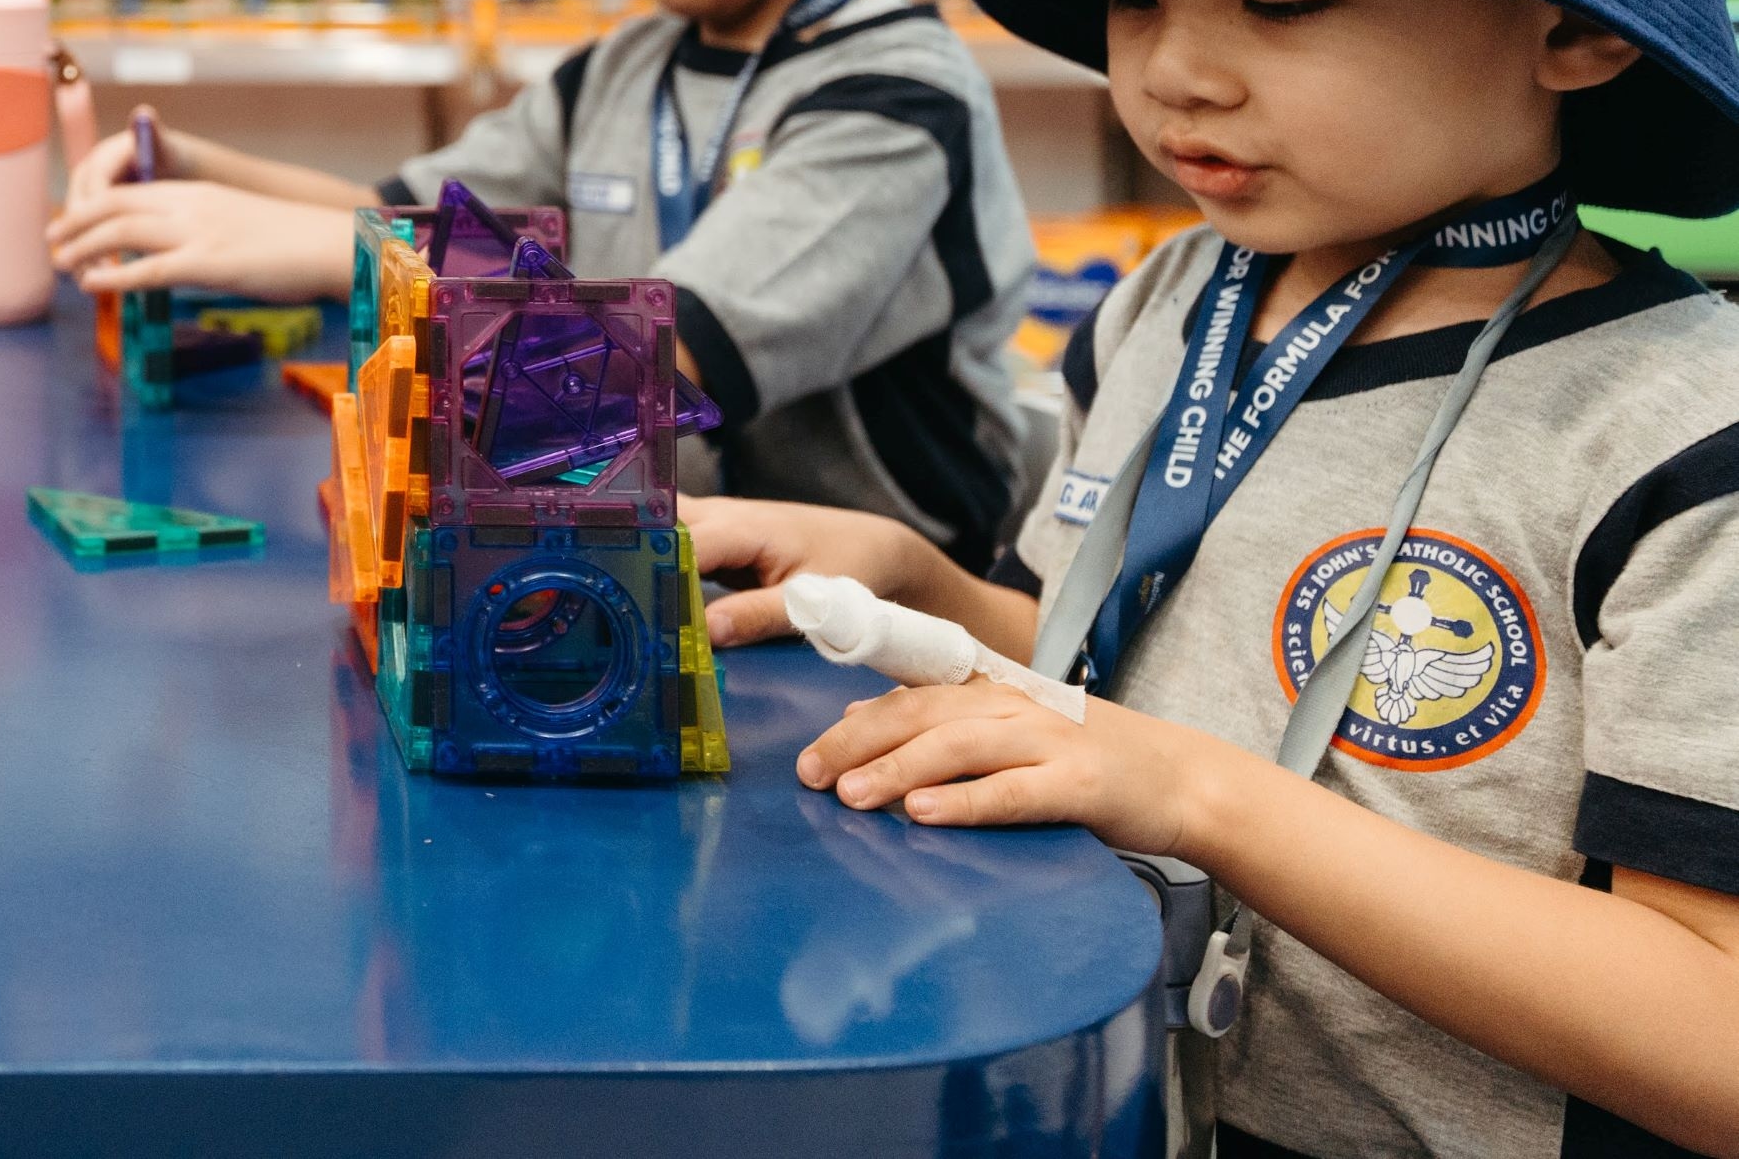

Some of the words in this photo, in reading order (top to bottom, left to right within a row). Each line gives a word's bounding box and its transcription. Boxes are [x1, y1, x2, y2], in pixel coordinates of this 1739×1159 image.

[1224, 244, 1255, 282] OR
[1435, 207, 1548, 249] INNING
[1189, 283, 1243, 401] WINNING
[1243, 303, 1351, 429] FORMULA
[1164, 406, 1207, 488] CHILD
[1310, 543, 1378, 589] JOHN'S
[1399, 542, 1489, 587] ATHOLIC
[1486, 584, 1528, 667] SCHOOL
[1349, 722, 1447, 755] virtus,
[1455, 723, 1483, 746] et
[1484, 684, 1524, 727] vita
